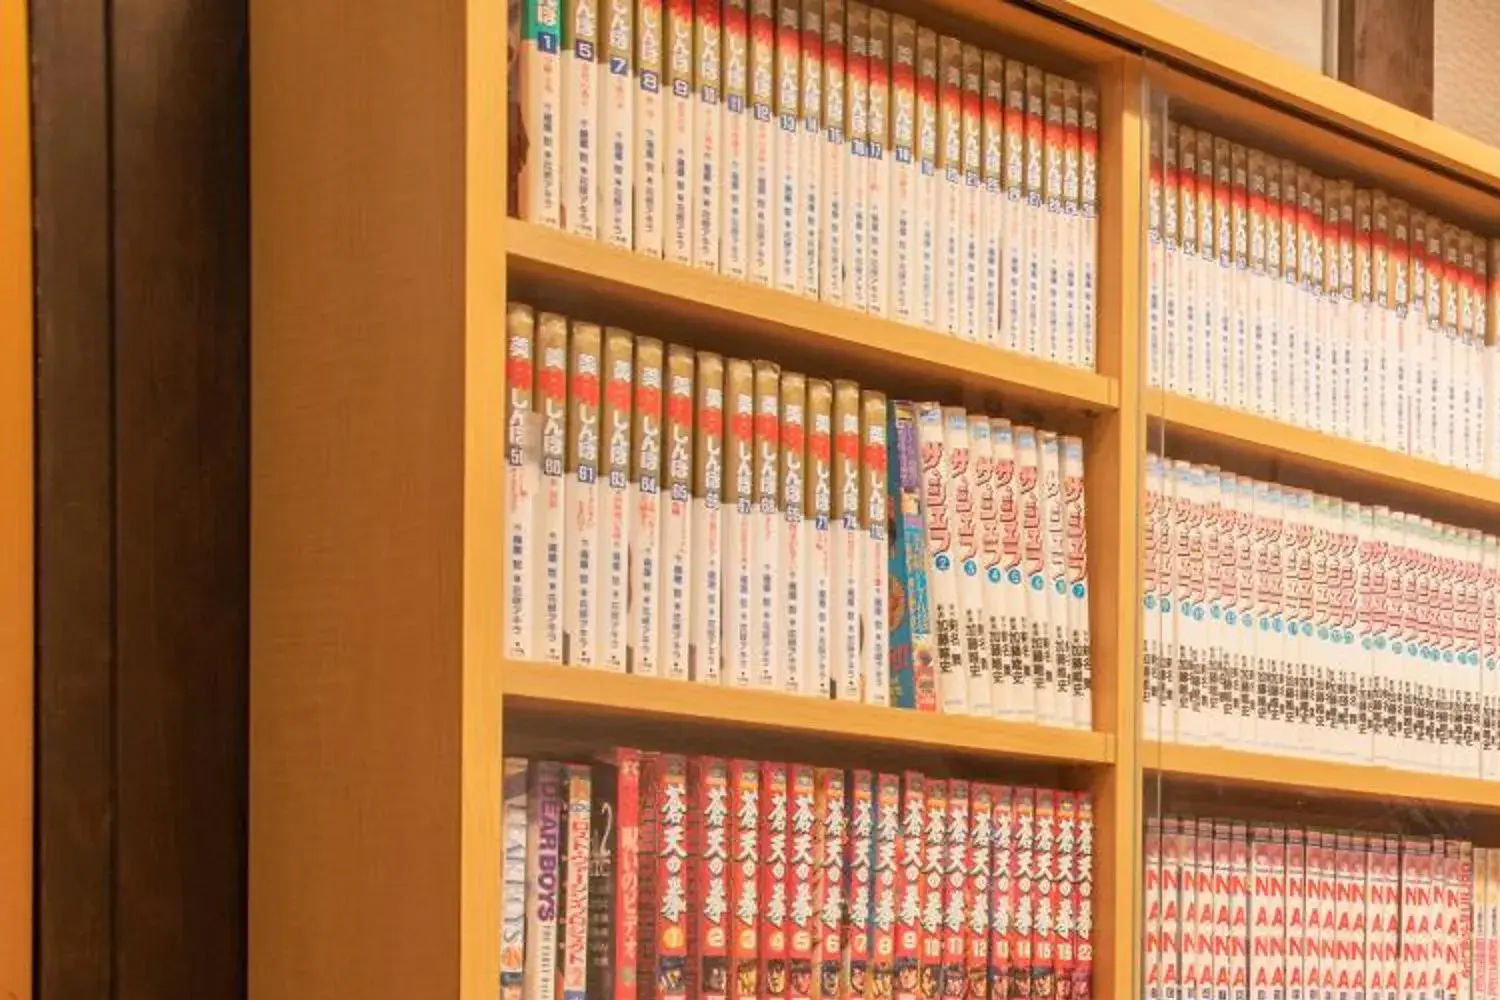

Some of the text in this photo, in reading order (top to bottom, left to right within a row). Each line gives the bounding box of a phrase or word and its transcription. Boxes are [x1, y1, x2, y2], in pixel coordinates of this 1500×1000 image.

[538, 783, 558, 922] DEAR BOYS
[660, 783, 688, 924] 蒼天の拳
[704, 786, 728, 925] 蒼天の拳
[737, 789, 758, 927] 蒼天の拳
[767, 793, 787, 928] 蒼天の拳
[792, 793, 815, 927] 蒼天の拳
[822, 798, 846, 929] 蒼天の拳
[850, 799, 871, 927] 蒼天の拳
[876, 803, 898, 932] 蒼天の拳
[898, 799, 924, 928] 蒼天の拳
[922, 806, 945, 934] 蒼天の拳
[945, 808, 968, 934] 蒼天の拳
[969, 812, 990, 935] 蒼天の拳
[992, 815, 1012, 935] 蒼天の拳
[1014, 816, 1034, 936] 蒼天の拳
[1032, 817, 1053, 937] 蒼天の拳
[1054, 819, 1075, 939] 蒼天の拳
[1076, 820, 1092, 940] 蒼天の拳
[1147, 869, 1160, 985] NANA
[1163, 870, 1178, 984] NANA
[1183, 871, 1197, 984] NANA
[1199, 872, 1213, 985] NANA
[1215, 875, 1230, 986] NANA
[1232, 875, 1247, 986] NANA
[1255, 876, 1269, 987] NANA
[1270, 877, 1284, 988] NANA
[1290, 877, 1304, 988] NANA
[1307, 877, 1320, 988] NANA
[1322, 881, 1334, 988] NANA
[1337, 882, 1351, 988] NANA
[1351, 882, 1365, 989] NANA
[1371, 884, 1383, 989] NANA
[1386, 884, 1399, 989] NANA
[1404, 886, 1416, 990] NANA
[1416, 886, 1430, 990] NANA
[1433, 884, 1445, 987] NANA
[1447, 889, 1459, 990] NANA
